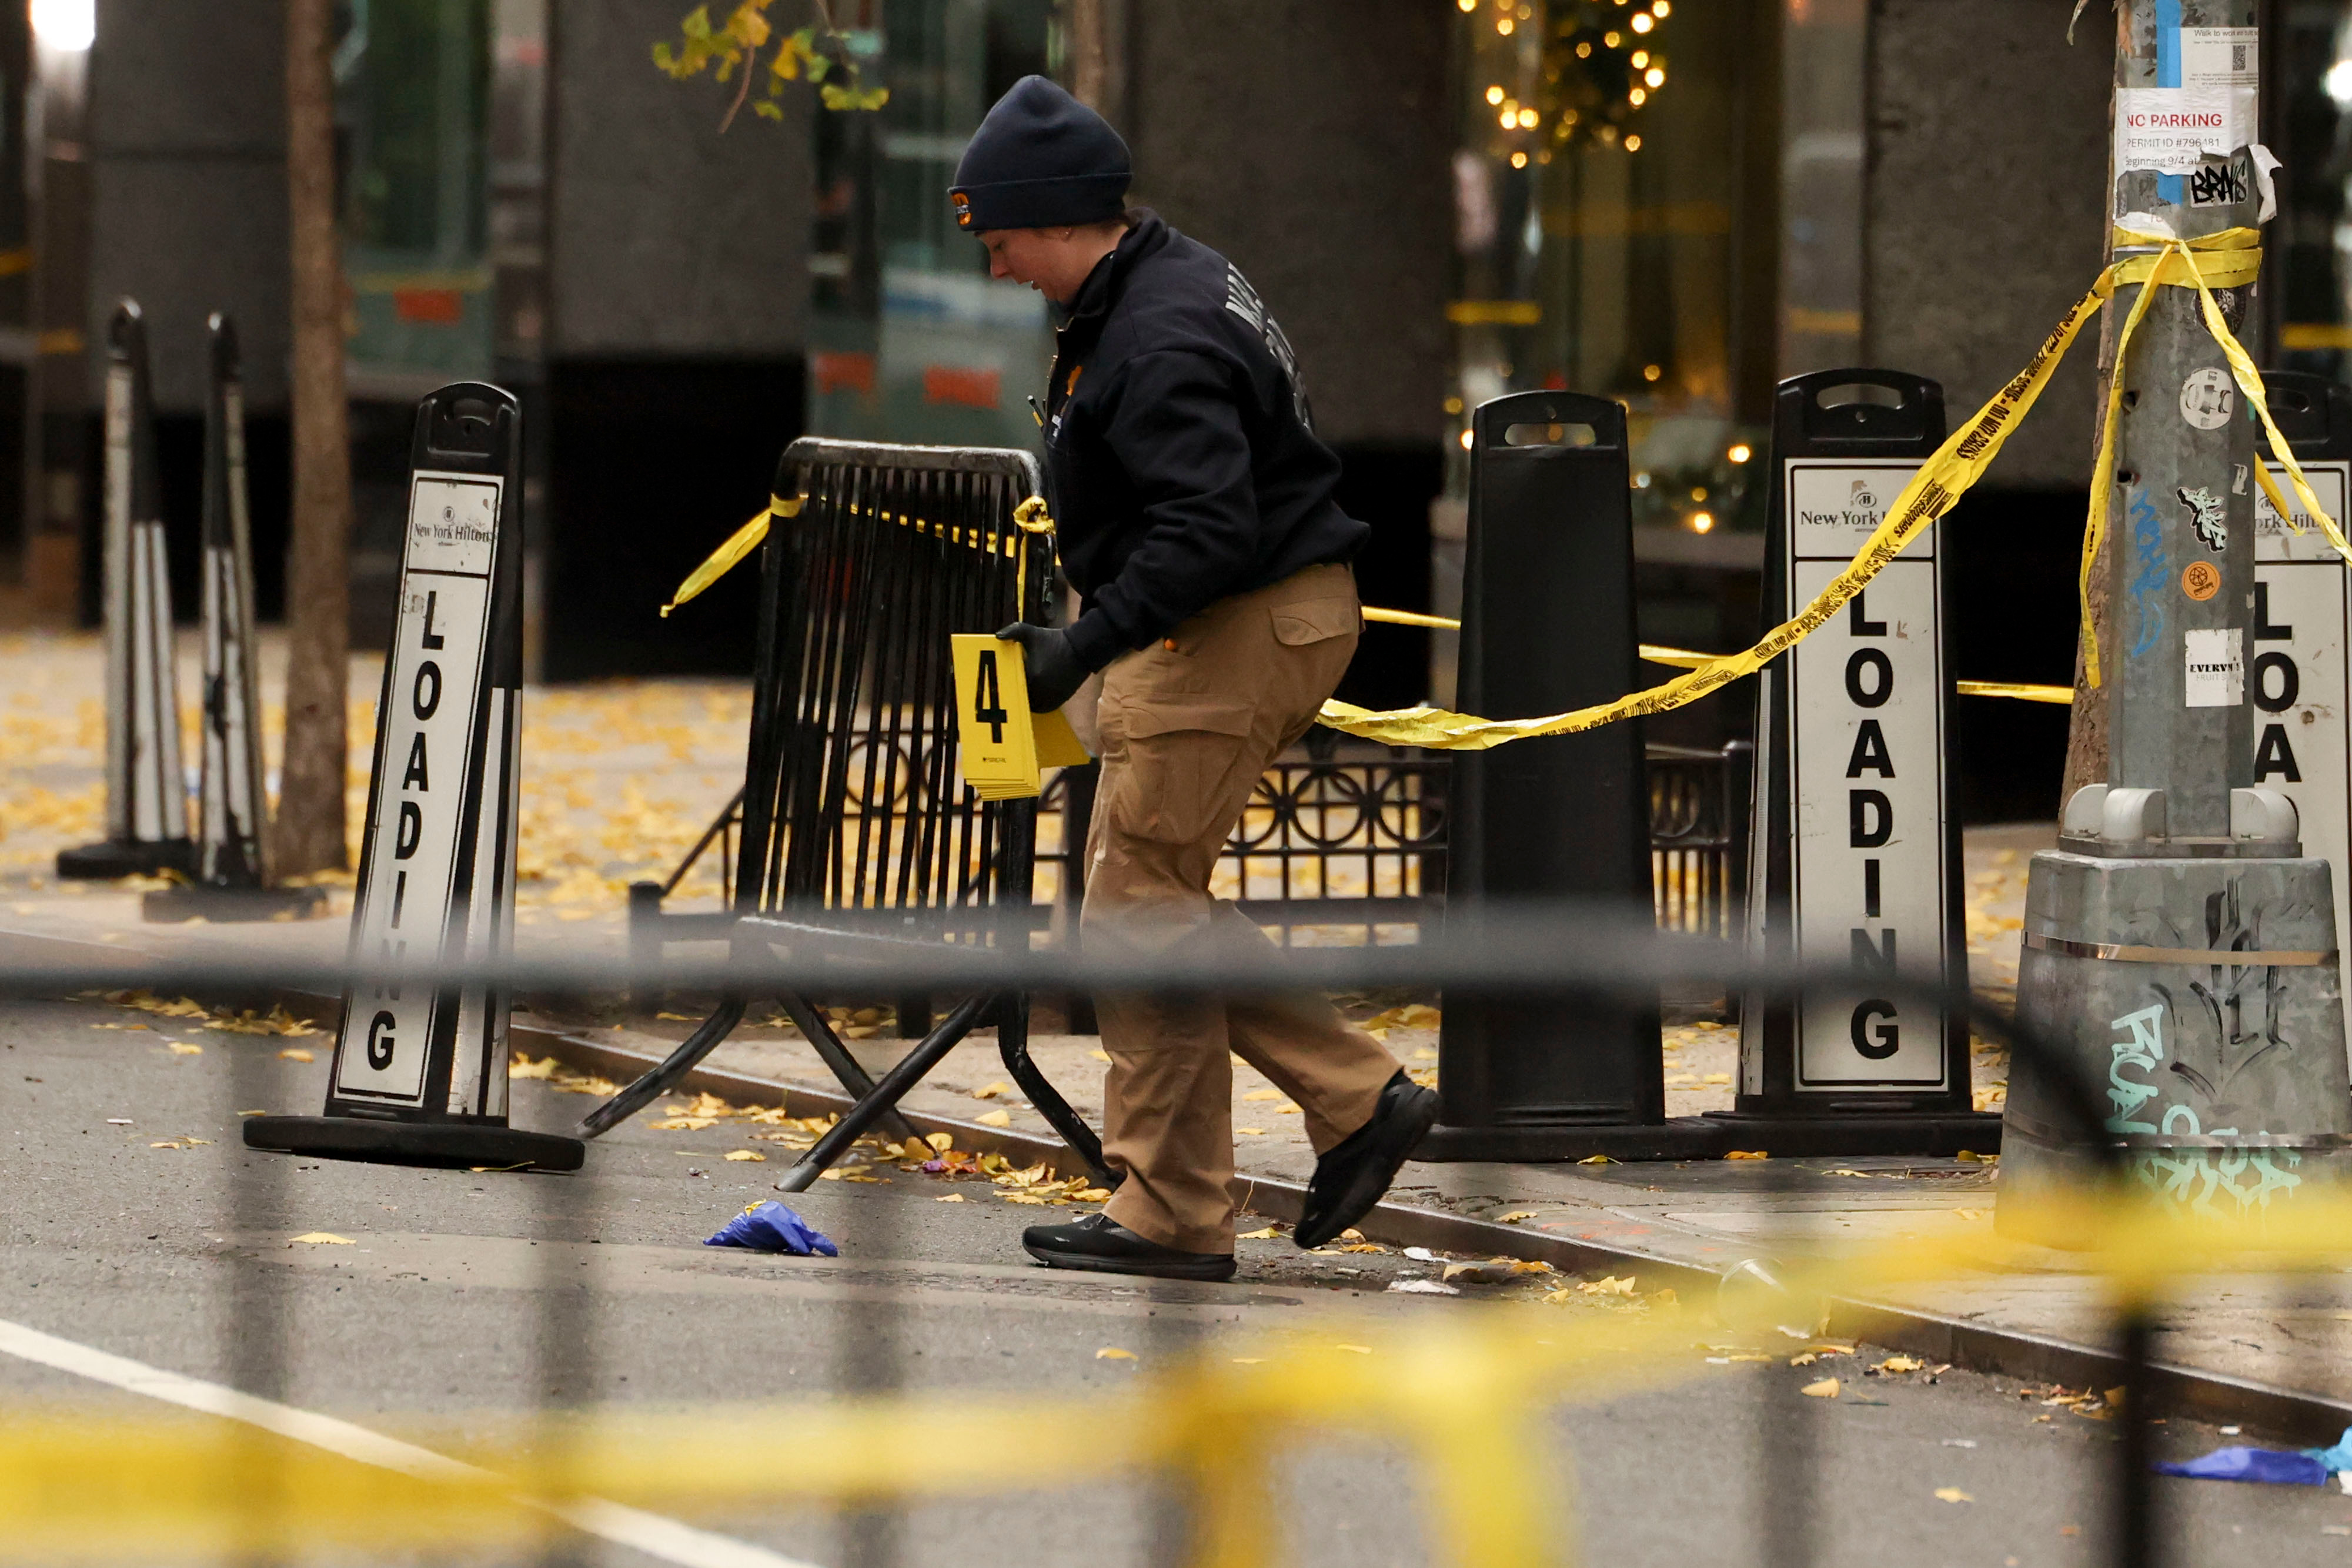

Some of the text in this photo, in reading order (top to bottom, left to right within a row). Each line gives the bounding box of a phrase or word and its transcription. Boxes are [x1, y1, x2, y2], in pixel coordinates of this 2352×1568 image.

[2127, 113, 2222, 126] NO PARKING
[2163, 138, 2173, 146] ID
[2126, 156, 2165, 168] eginning
[2168, 156, 2184, 165] 9/4
[1977, 416, 2002, 437] NOT
[1956, 430, 1990, 460] CROSS
[1801, 511, 1838, 525] New
[1842, 511, 1878, 525] York
[2254, 514, 2281, 529] ork
[414, 523, 490, 542] New York Hilton
[975, 650, 1007, 743] 4
[1845, 587, 1899, 1059] LOADING
